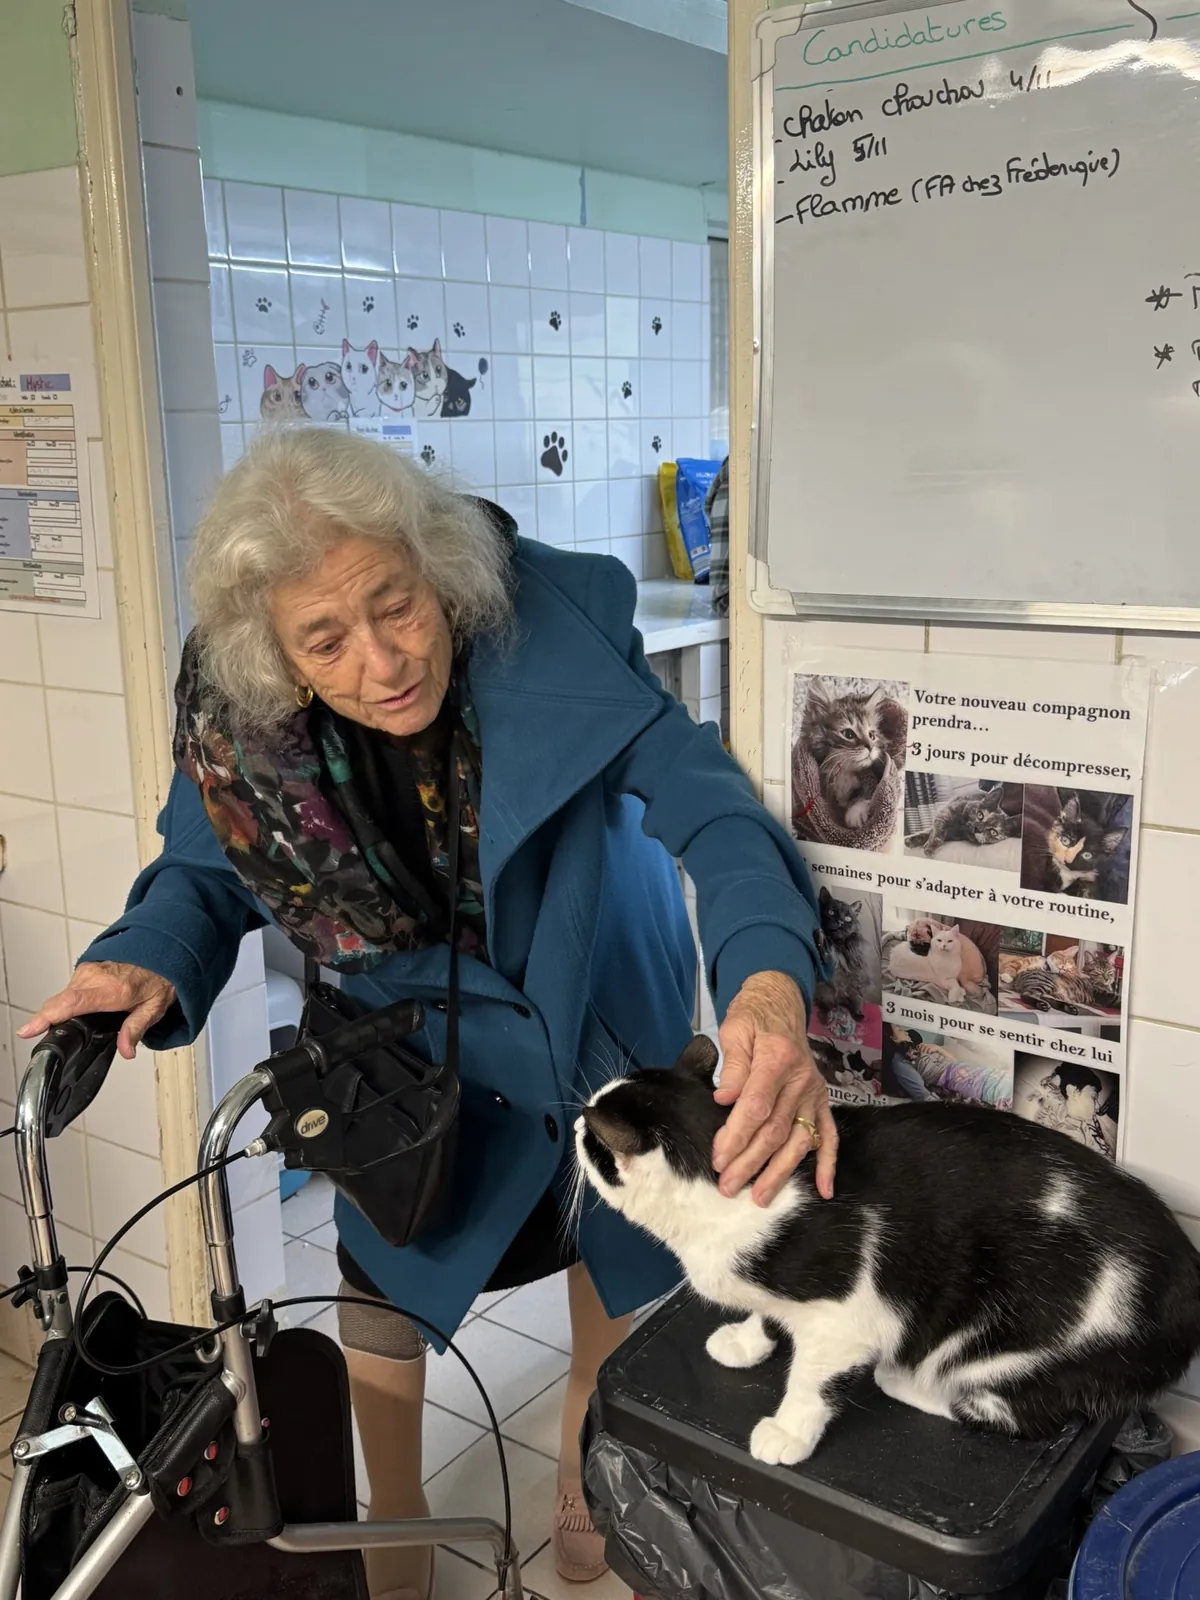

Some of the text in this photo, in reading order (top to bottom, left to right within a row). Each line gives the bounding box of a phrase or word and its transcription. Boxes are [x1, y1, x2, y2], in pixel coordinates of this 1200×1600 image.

[803, 11, 1007, 65] Candidatures
[789, 141, 836, 187] Lily
[912, 174, 956, 203] (FA
[914, 689, 1131, 722] Votre nouveau compagnon
[911, 742, 1132, 779] 3 jours pour décompresser,
[811, 862, 873, 882] semaines
[877, 873, 912, 888] pour
[988, 888, 997, 902] à
[1002, 893, 1044, 910] votre
[1049, 902, 1115, 924] routine,
[886, 1000, 1113, 1064] 3 mois pour se sentir chez lui
[301, 1115, 326, 1134] drive
